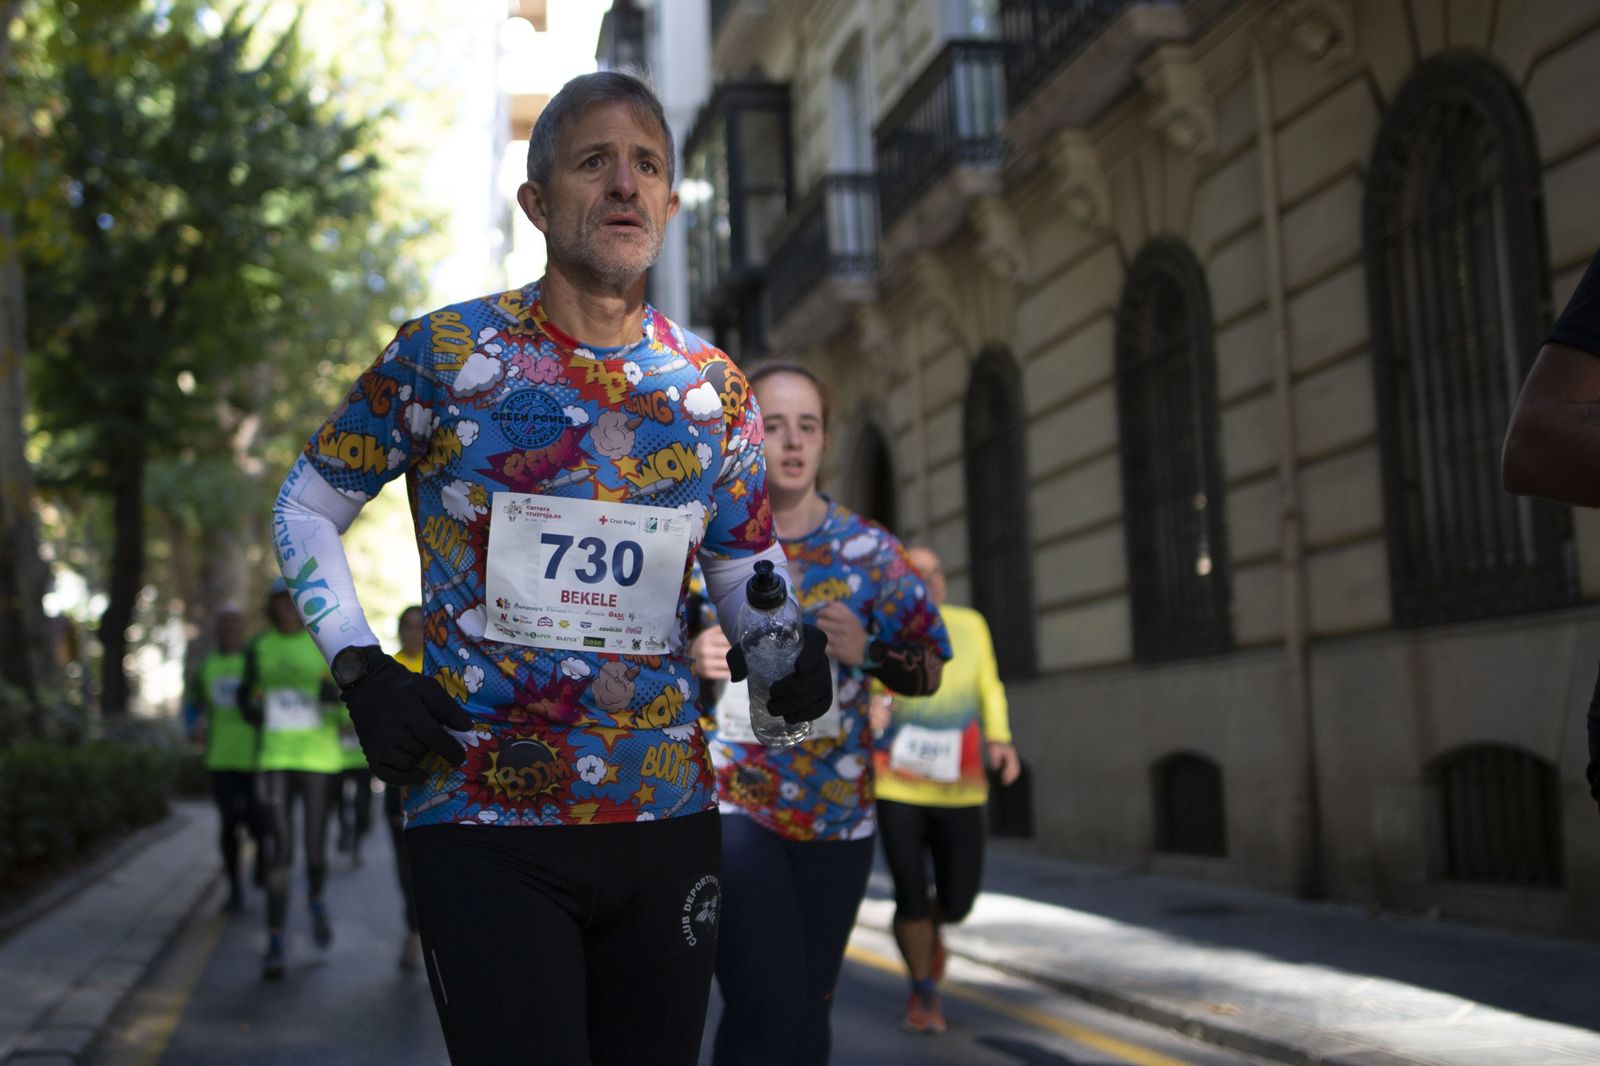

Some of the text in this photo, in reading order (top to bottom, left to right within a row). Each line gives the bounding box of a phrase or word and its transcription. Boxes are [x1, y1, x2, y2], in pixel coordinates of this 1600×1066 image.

[429, 311, 475, 371] BOOM
[490, 412, 573, 425] GREEN POWER
[318, 424, 388, 475] WOW
[625, 441, 703, 494] WOW
[525, 511, 562, 520] cruzroja.es
[526, 504, 551, 512] carrera
[623, 519, 636, 527] Roja
[540, 532, 644, 587] 730
[560, 589, 618, 608] BEKELE
[682, 915, 697, 946] CLUB
